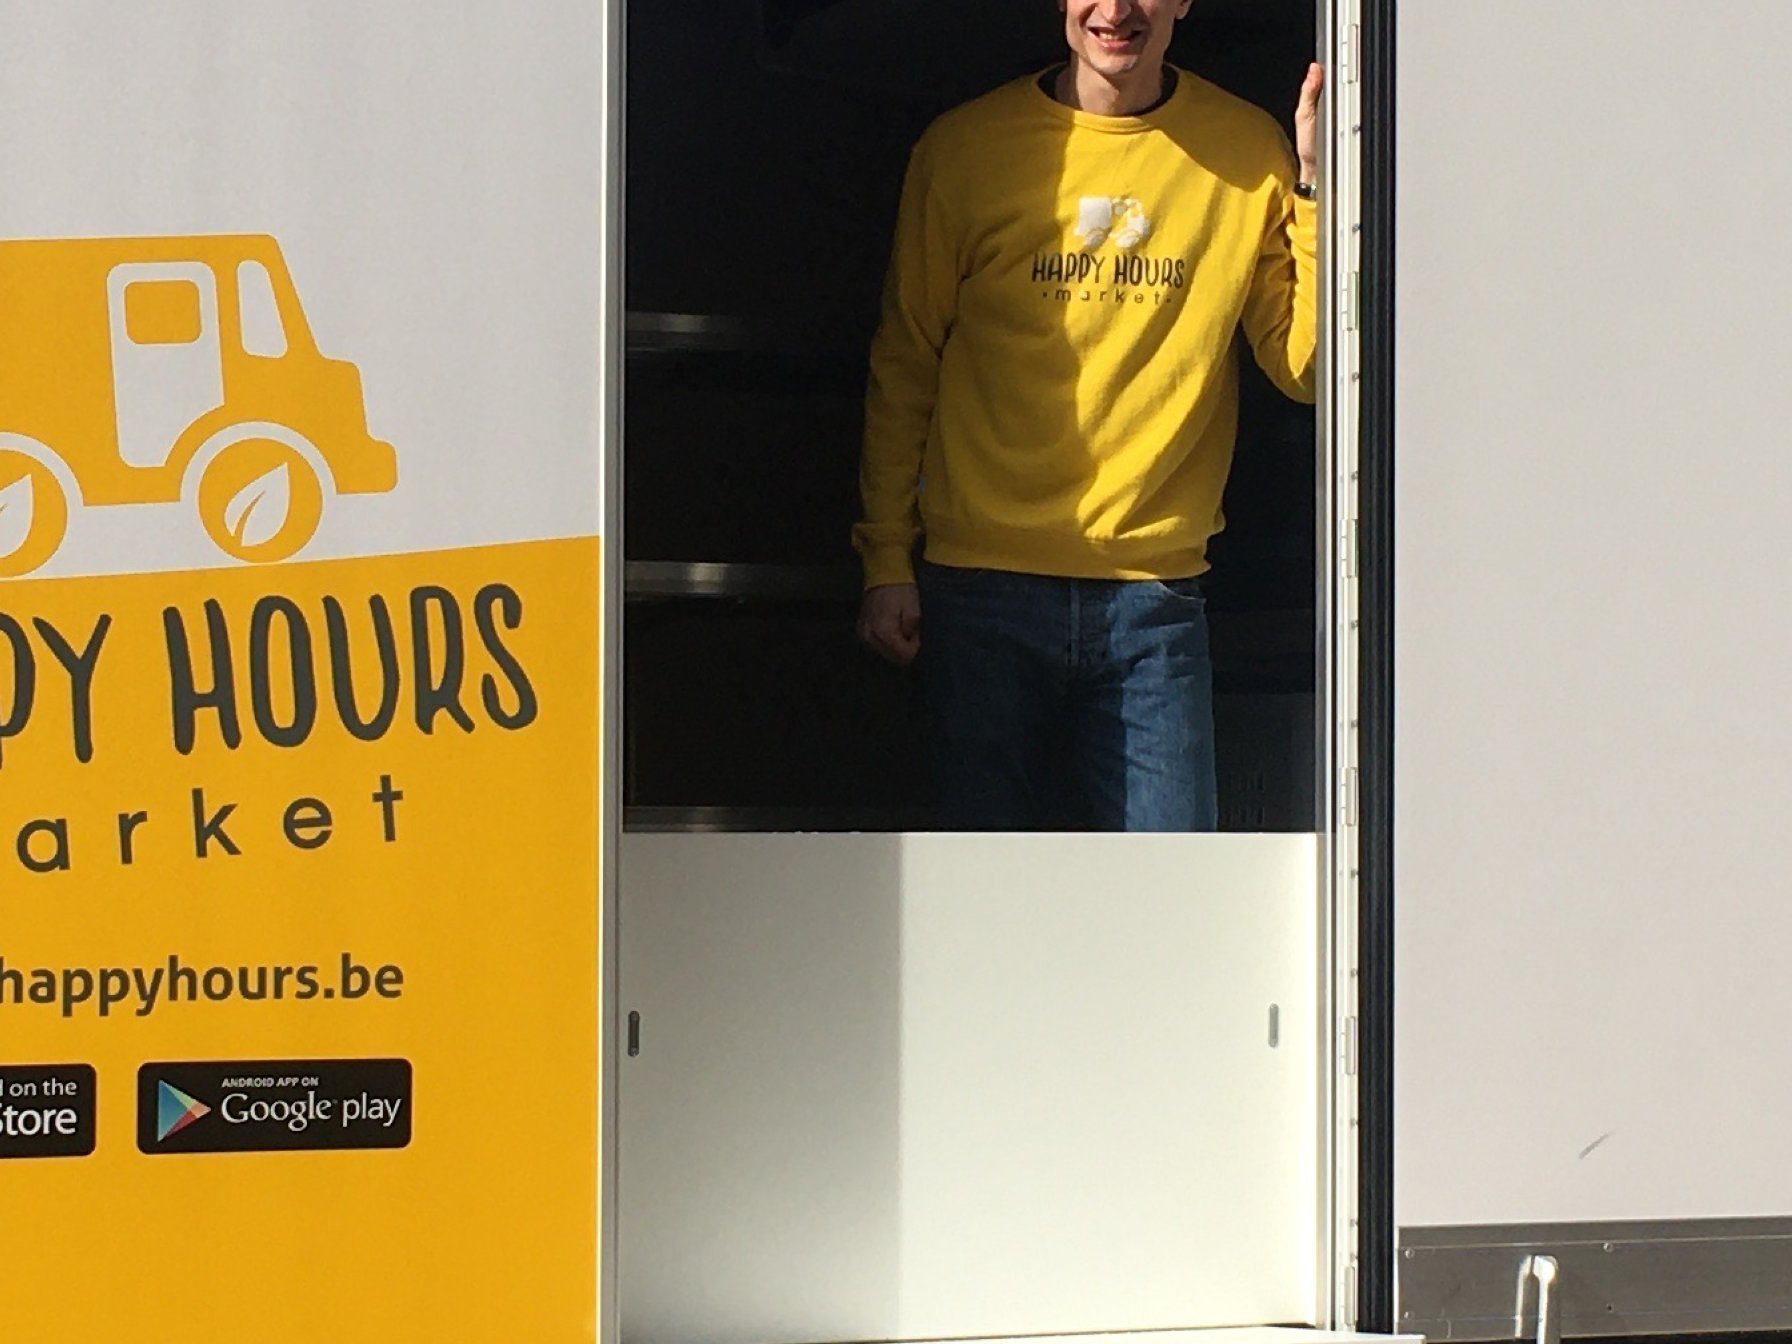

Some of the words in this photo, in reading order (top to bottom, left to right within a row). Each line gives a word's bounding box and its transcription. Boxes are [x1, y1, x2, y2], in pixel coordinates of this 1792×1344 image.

[1032, 253, 1106, 284] HAPPY
[1113, 255, 1186, 289] HOURS
[162, 583, 538, 756] HOURS
[9, 1082, 37, 1097] on
[42, 1077, 77, 1096] the
[221, 1077, 275, 1088] ANDROID
[275, 1077, 300, 1087] APP
[301, 1076, 319, 1087] ON
[221, 1090, 332, 1132] Google
[342, 1091, 402, 1128] play
